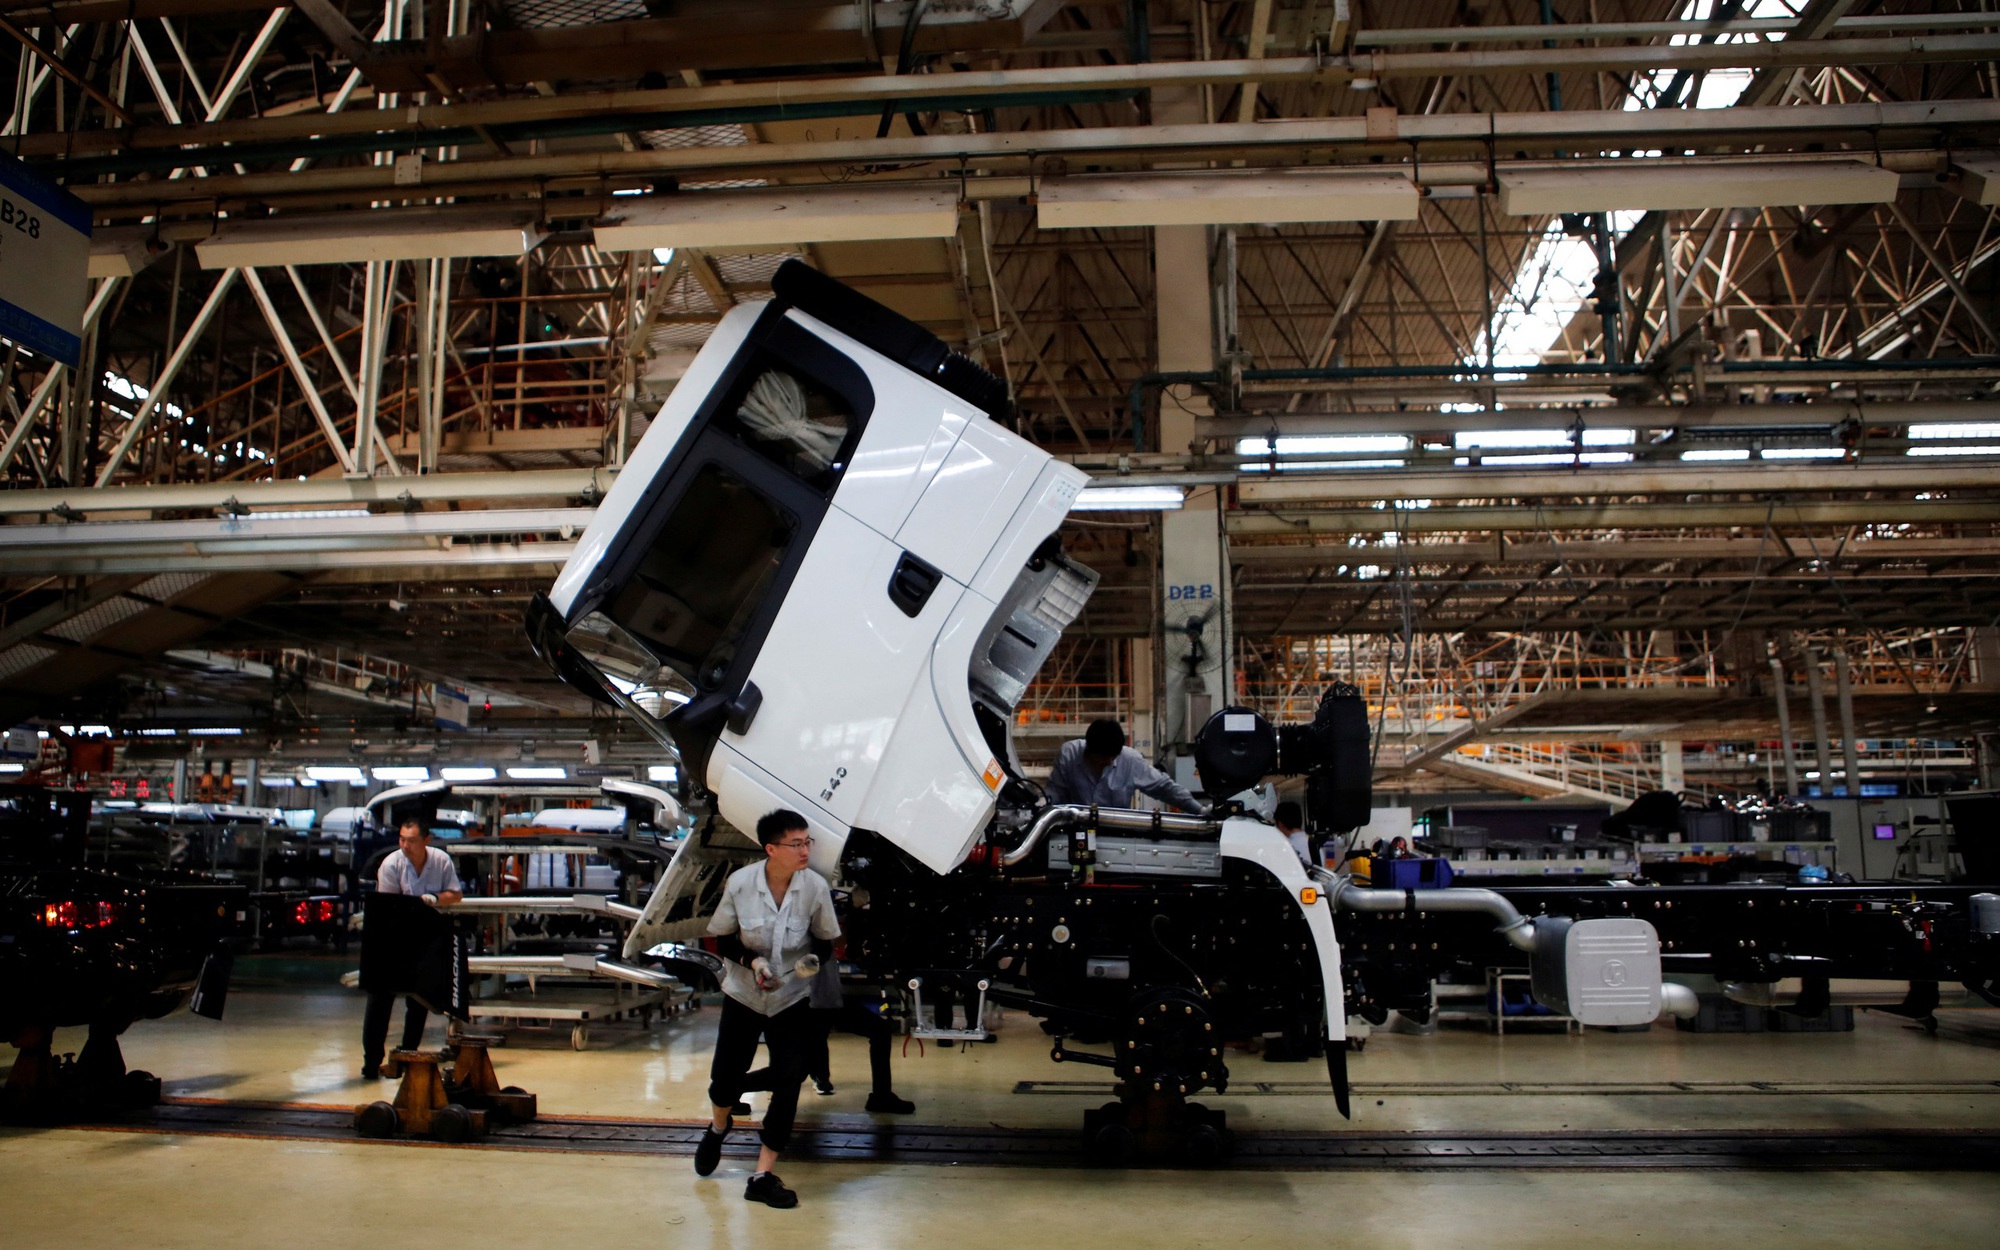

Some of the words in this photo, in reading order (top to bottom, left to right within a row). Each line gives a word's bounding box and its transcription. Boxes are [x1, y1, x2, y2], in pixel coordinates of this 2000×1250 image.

[1, 198, 41, 240] B28
[1169, 584, 1213, 600] D22
[820, 766, 847, 802] 340
